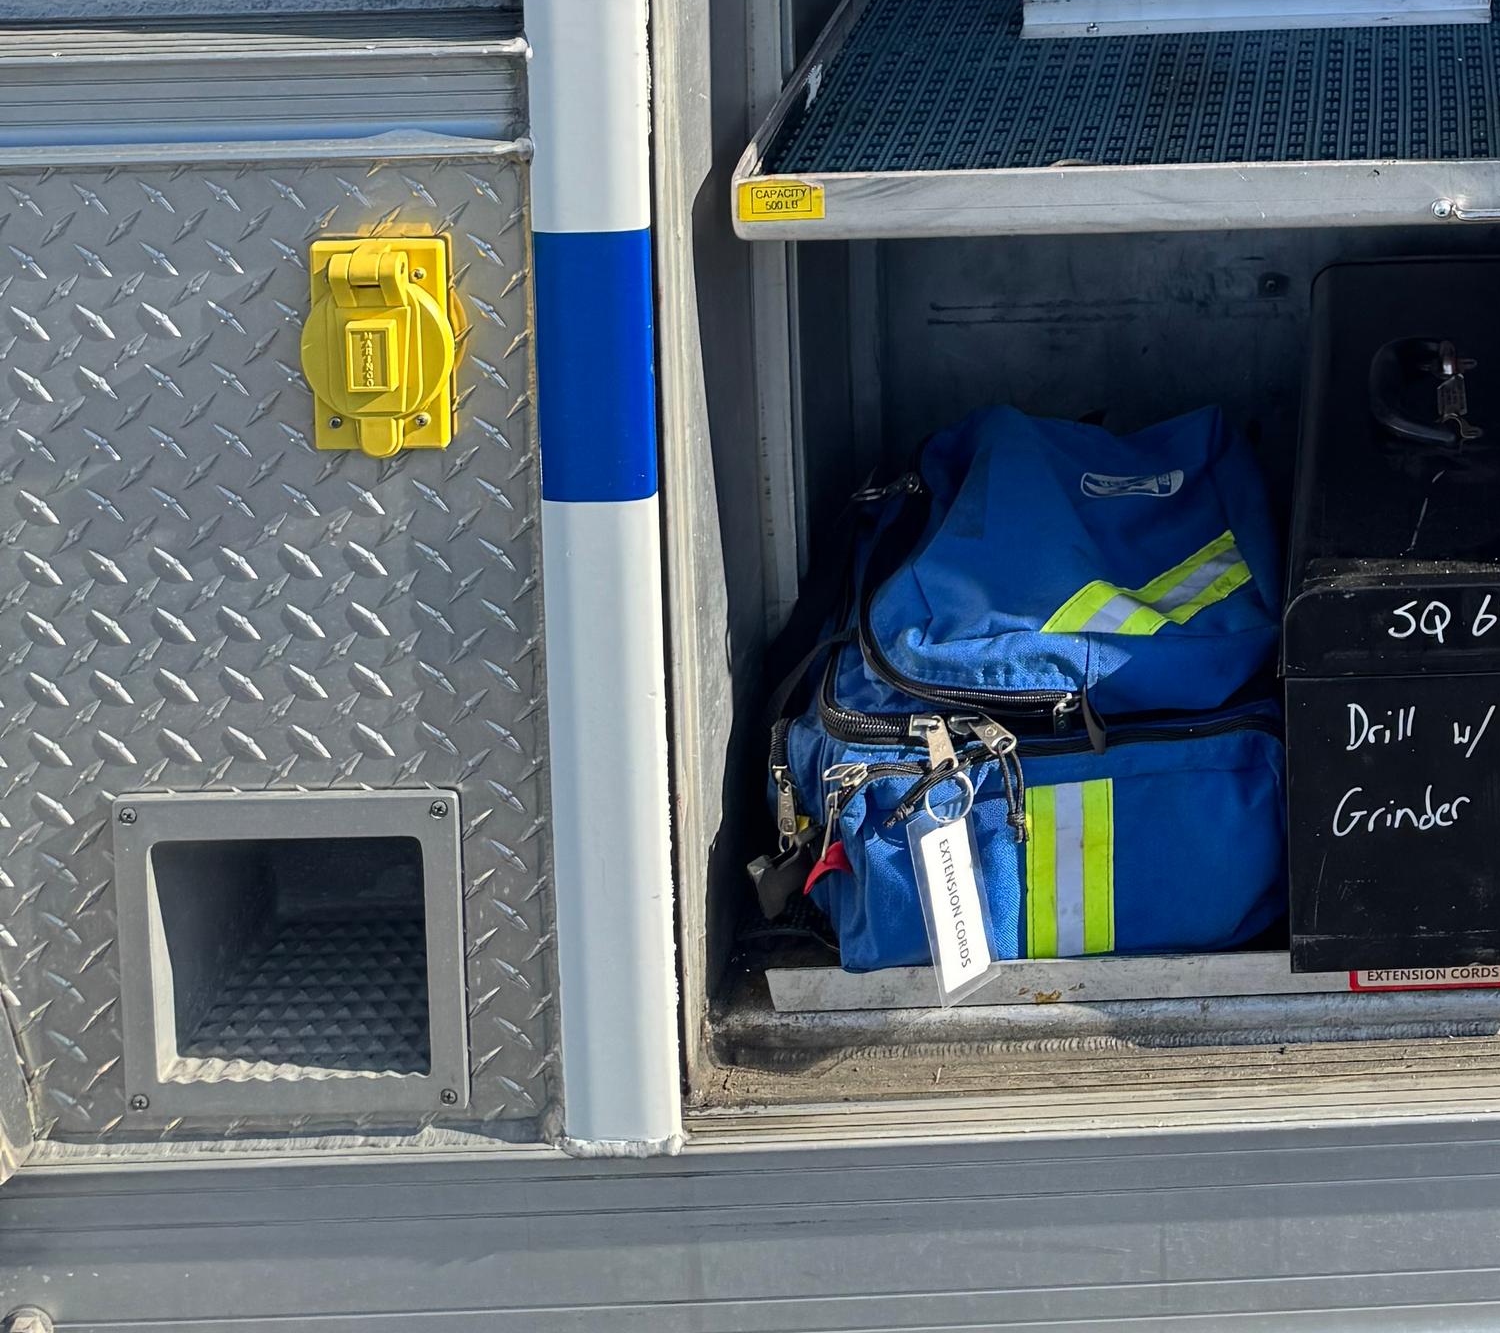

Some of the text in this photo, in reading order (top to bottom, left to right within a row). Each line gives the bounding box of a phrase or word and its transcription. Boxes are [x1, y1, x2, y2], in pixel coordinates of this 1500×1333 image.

[755, 187, 808, 199] CAPACITY
[765, 199, 799, 211] 500 LB
[1389, 600, 1452, 644] SQ
[1346, 703, 1416, 751] Drill
[1453, 704, 1496, 758] w/
[1333, 784, 1471, 837] Grinder
[939, 838, 972, 969] EXTENSION CORDS
[1367, 966, 1500, 982] EXTENSION CORDS
